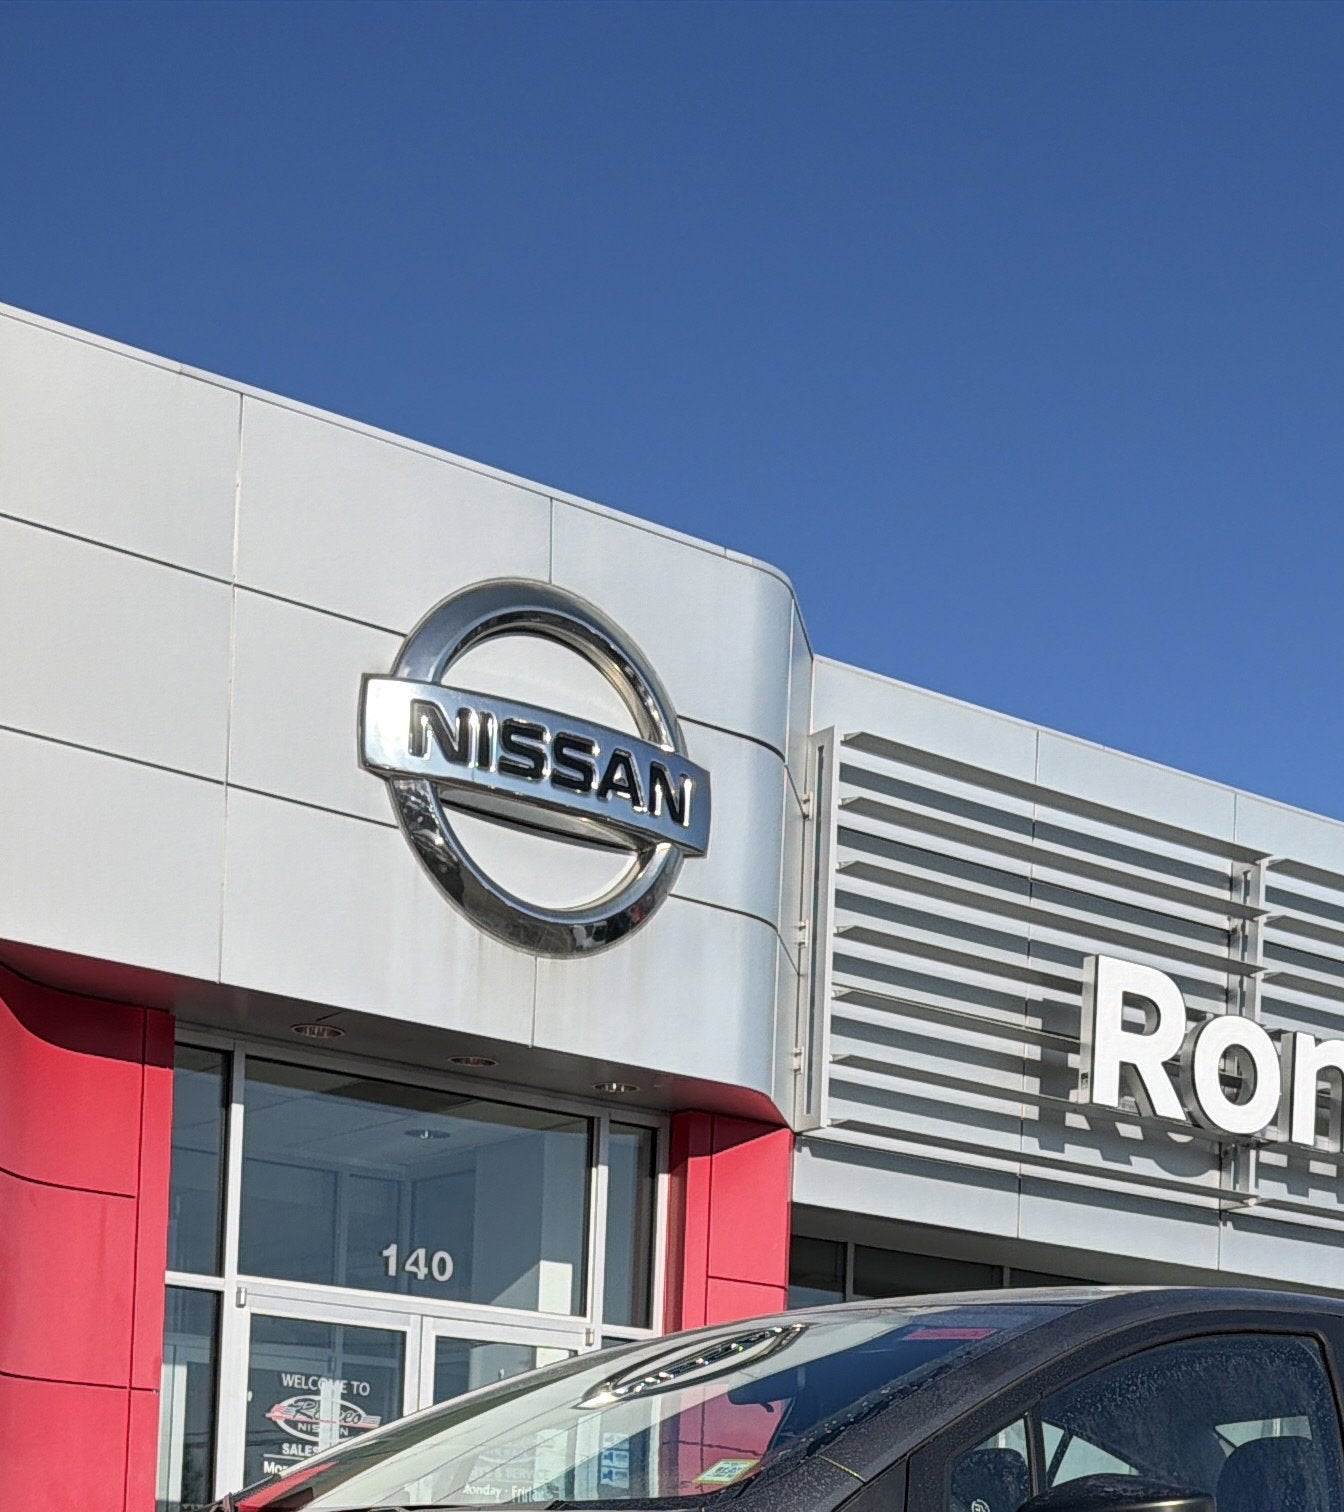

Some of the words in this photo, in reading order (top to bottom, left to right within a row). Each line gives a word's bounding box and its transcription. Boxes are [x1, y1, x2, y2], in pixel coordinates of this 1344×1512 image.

[408, 697, 693, 829] NISSAN
[381, 1243, 454, 1282] 140
[351, 1380, 370, 1397] TO
[297, 1422, 349, 1436] NISN
